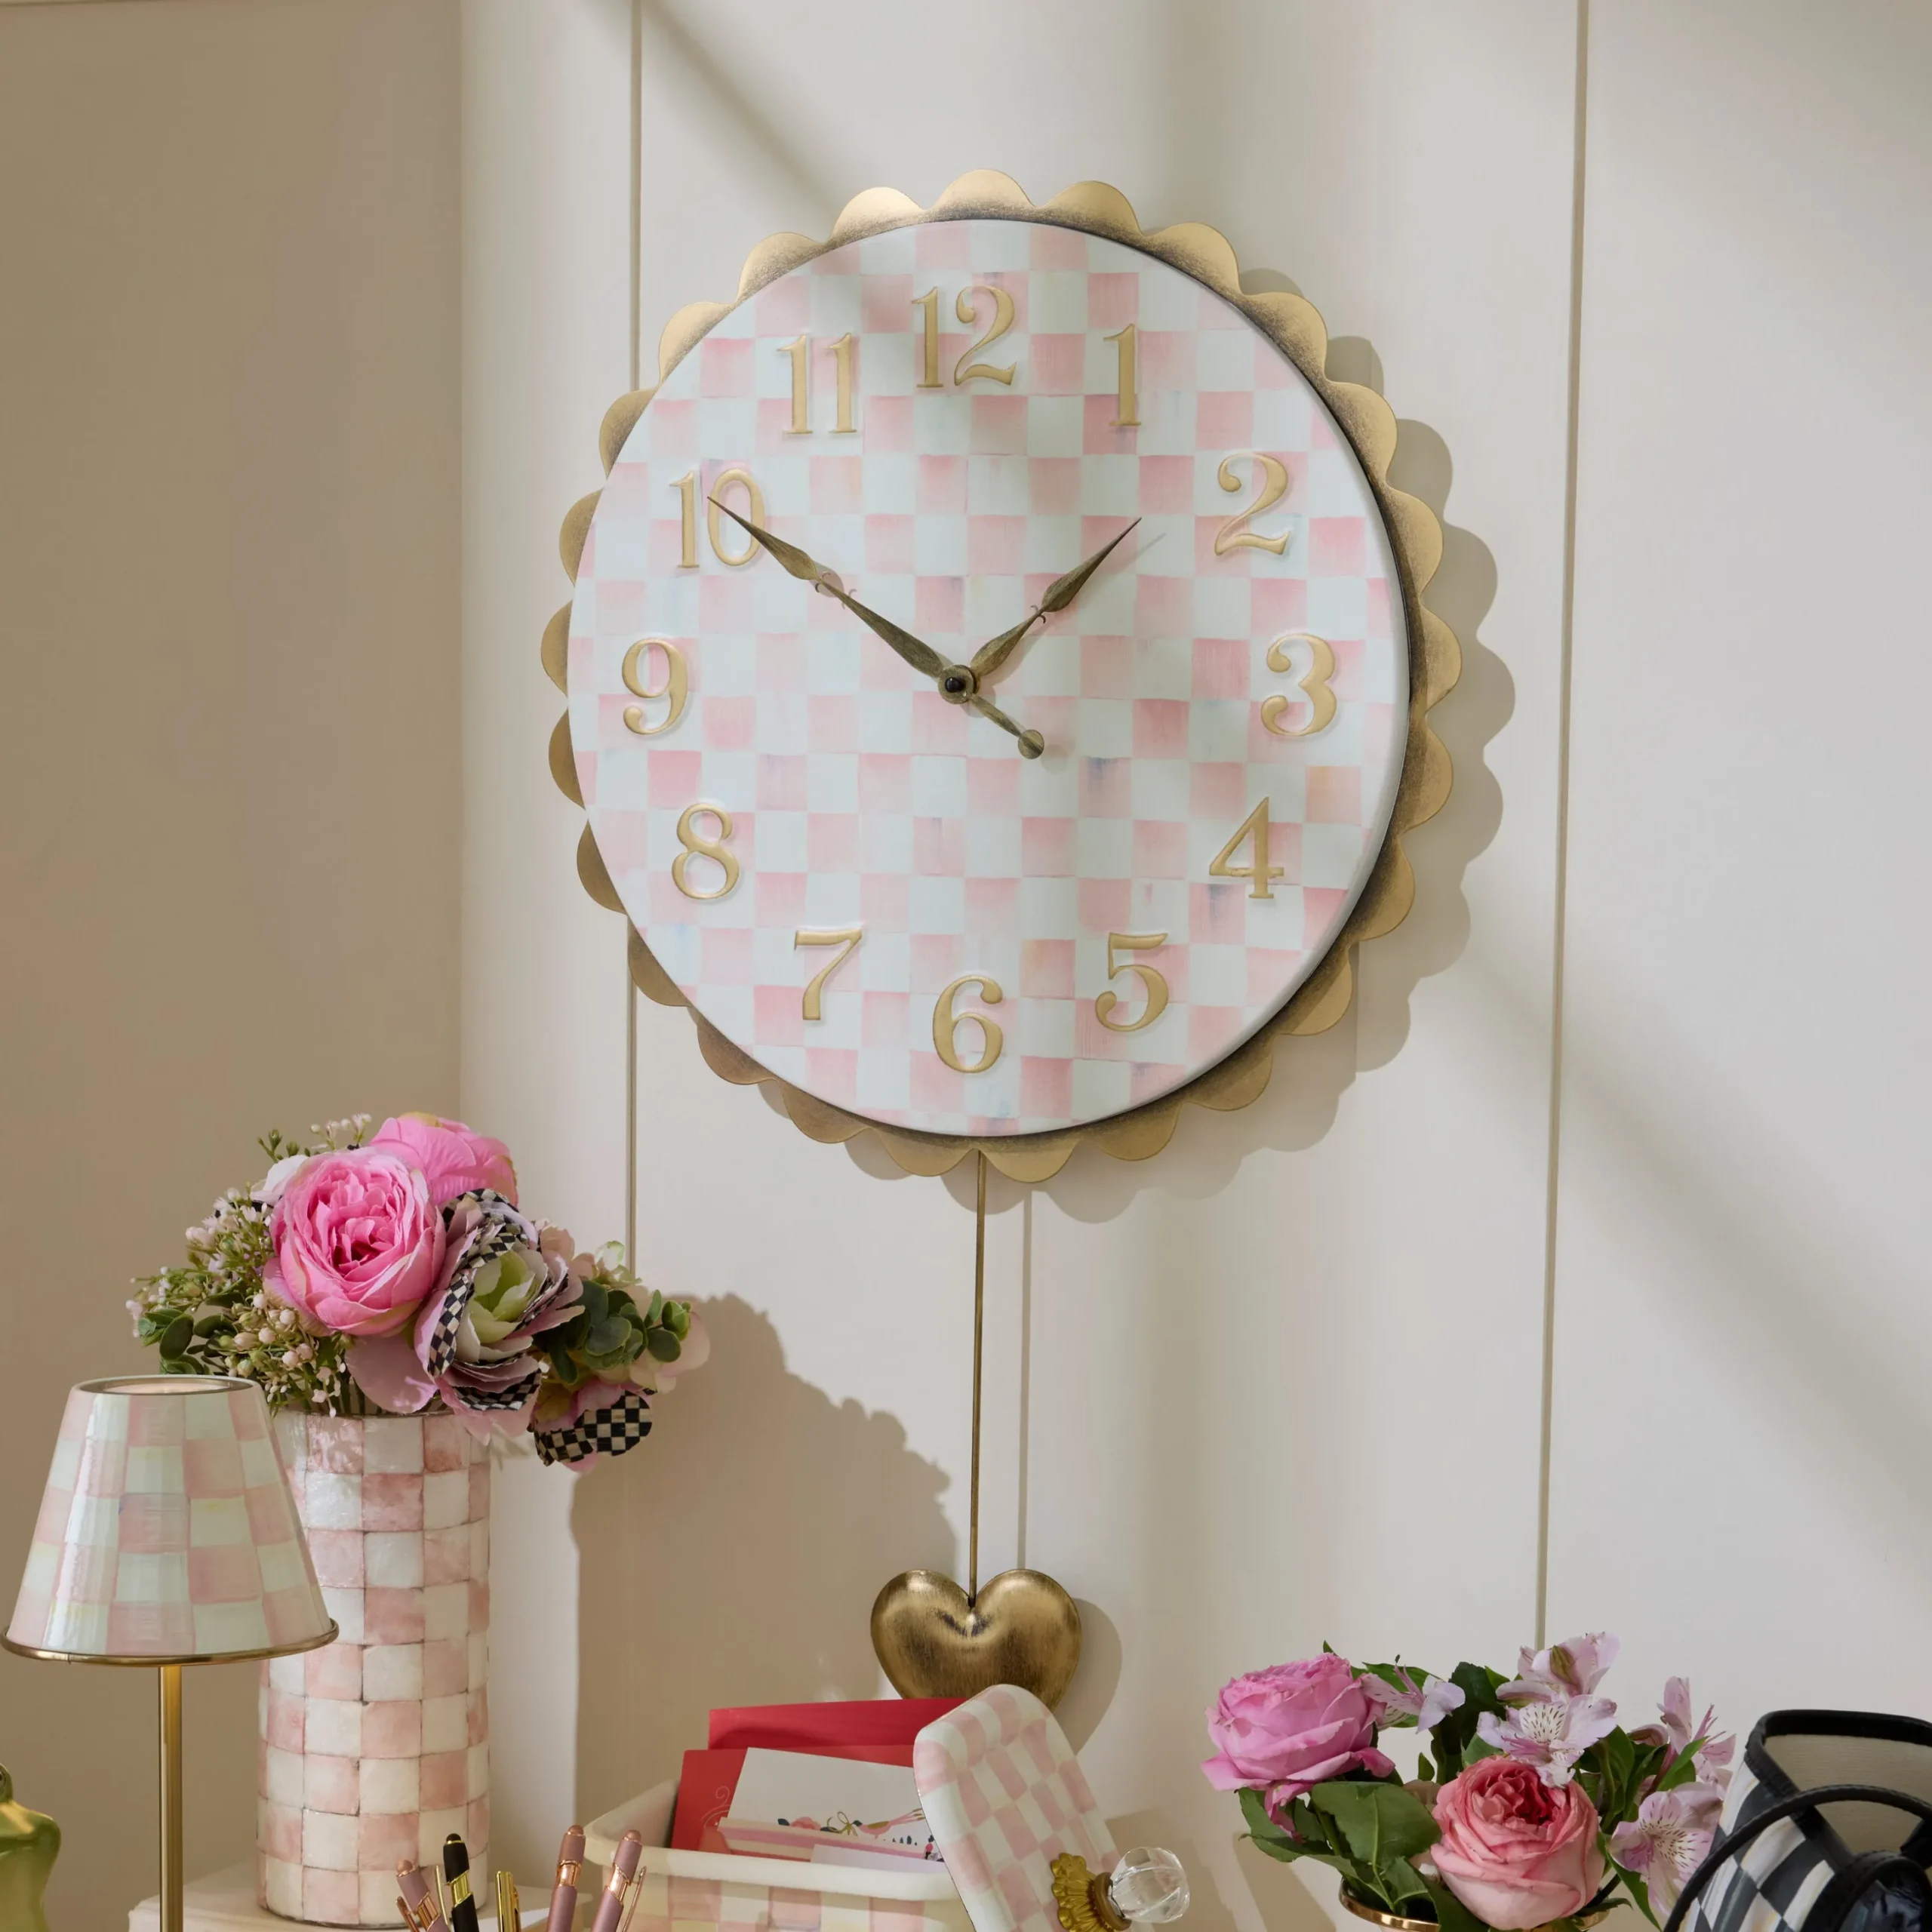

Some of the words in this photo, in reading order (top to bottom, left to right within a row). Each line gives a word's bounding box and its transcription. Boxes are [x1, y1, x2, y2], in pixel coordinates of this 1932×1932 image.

[777, 333, 857, 434] 11
[912, 285, 1017, 388] 12
[1103, 323, 1142, 426] 1
[669, 468, 764, 568] 10
[1214, 453, 1290, 556] 2
[621, 638, 688, 735] 9
[1261, 633, 1337, 737] 3
[672, 803, 740, 900] 8
[1209, 796, 1284, 900] 4
[794, 929, 863, 1020] 7
[933, 975, 1003, 1074] 6
[1095, 932, 1169, 1032] 5
